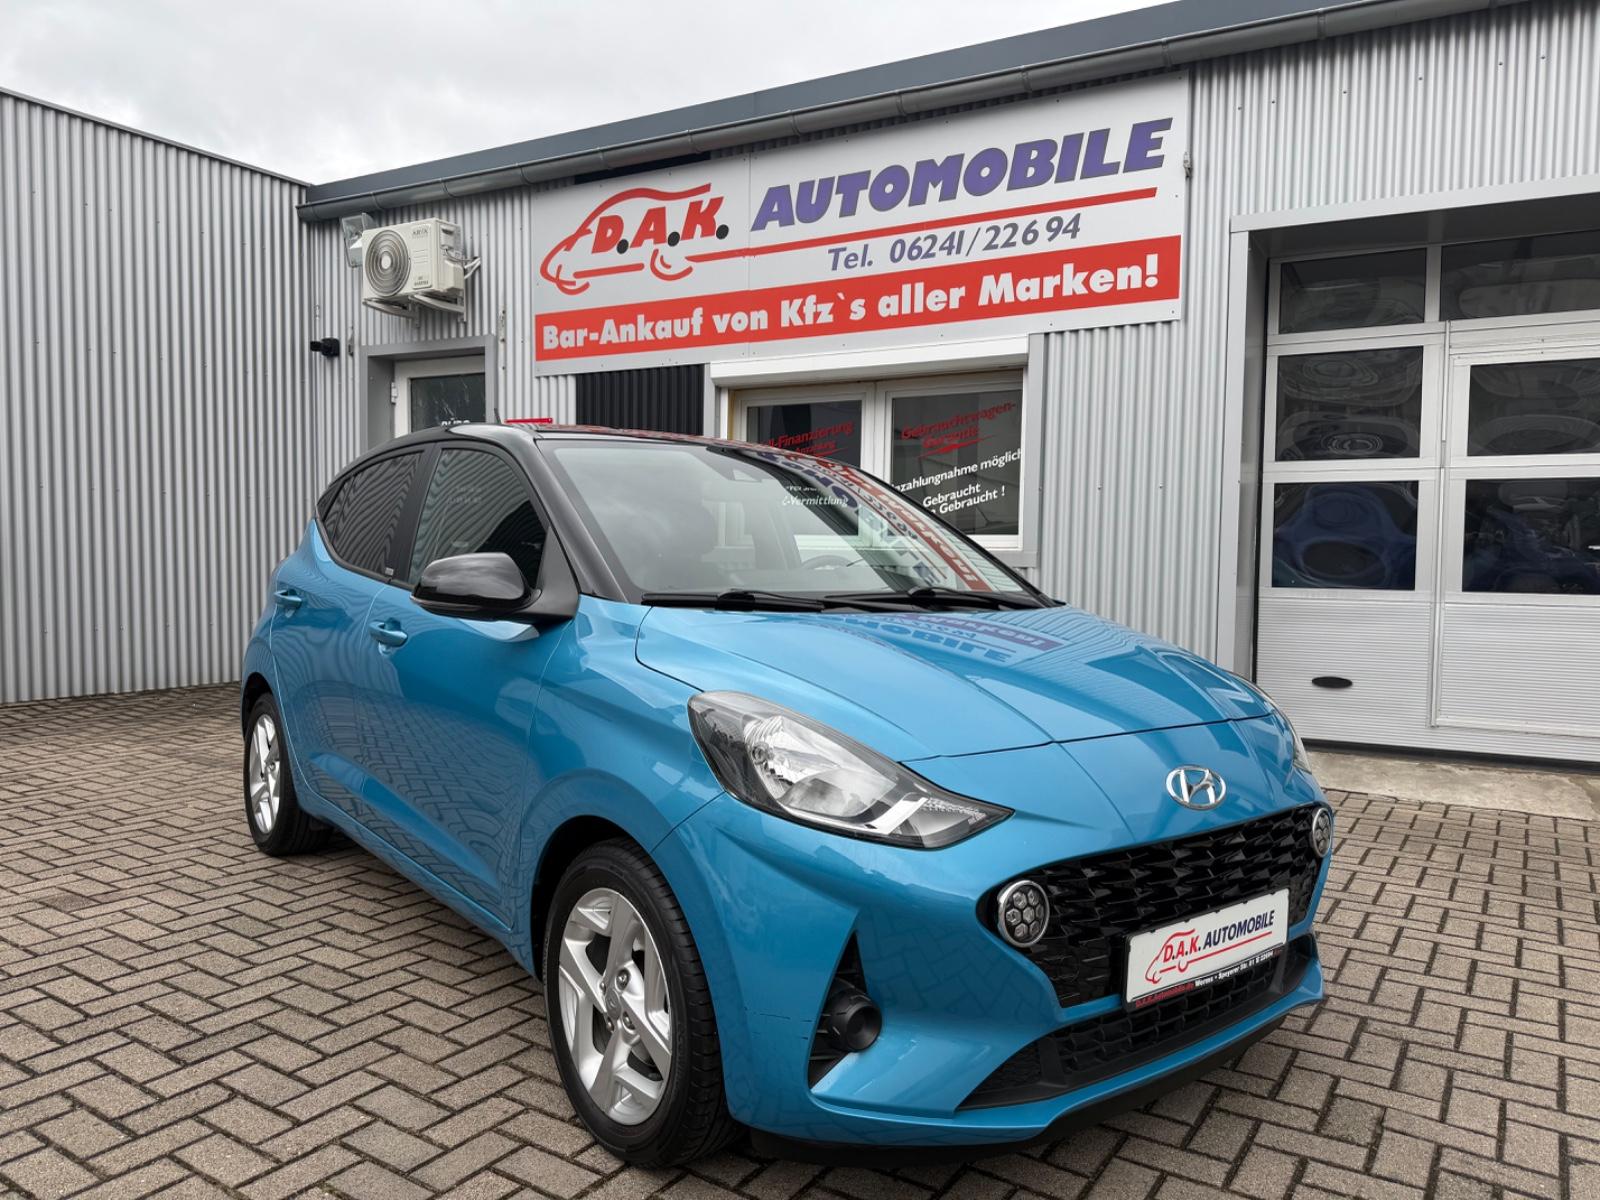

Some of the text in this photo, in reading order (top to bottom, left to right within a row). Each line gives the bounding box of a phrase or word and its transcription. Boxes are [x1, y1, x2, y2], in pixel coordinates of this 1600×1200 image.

[591, 117, 1173, 255] D.A.K. AUTOMOBILE
[827, 243, 874, 271] Tel.
[543, 307, 703, 350] Bar-Ankauf
[712, 308, 768, 334] von
[878, 283, 966, 317] aller
[978, 253, 1159, 307] Marken!
[891, 464, 978, 492] nzahlungnahme
[923, 483, 981, 507] Gebraucht
[939, 489, 998, 514] Gebraucht
[1163, 910, 1275, 963] D.A.K. AUTOMOBILE
